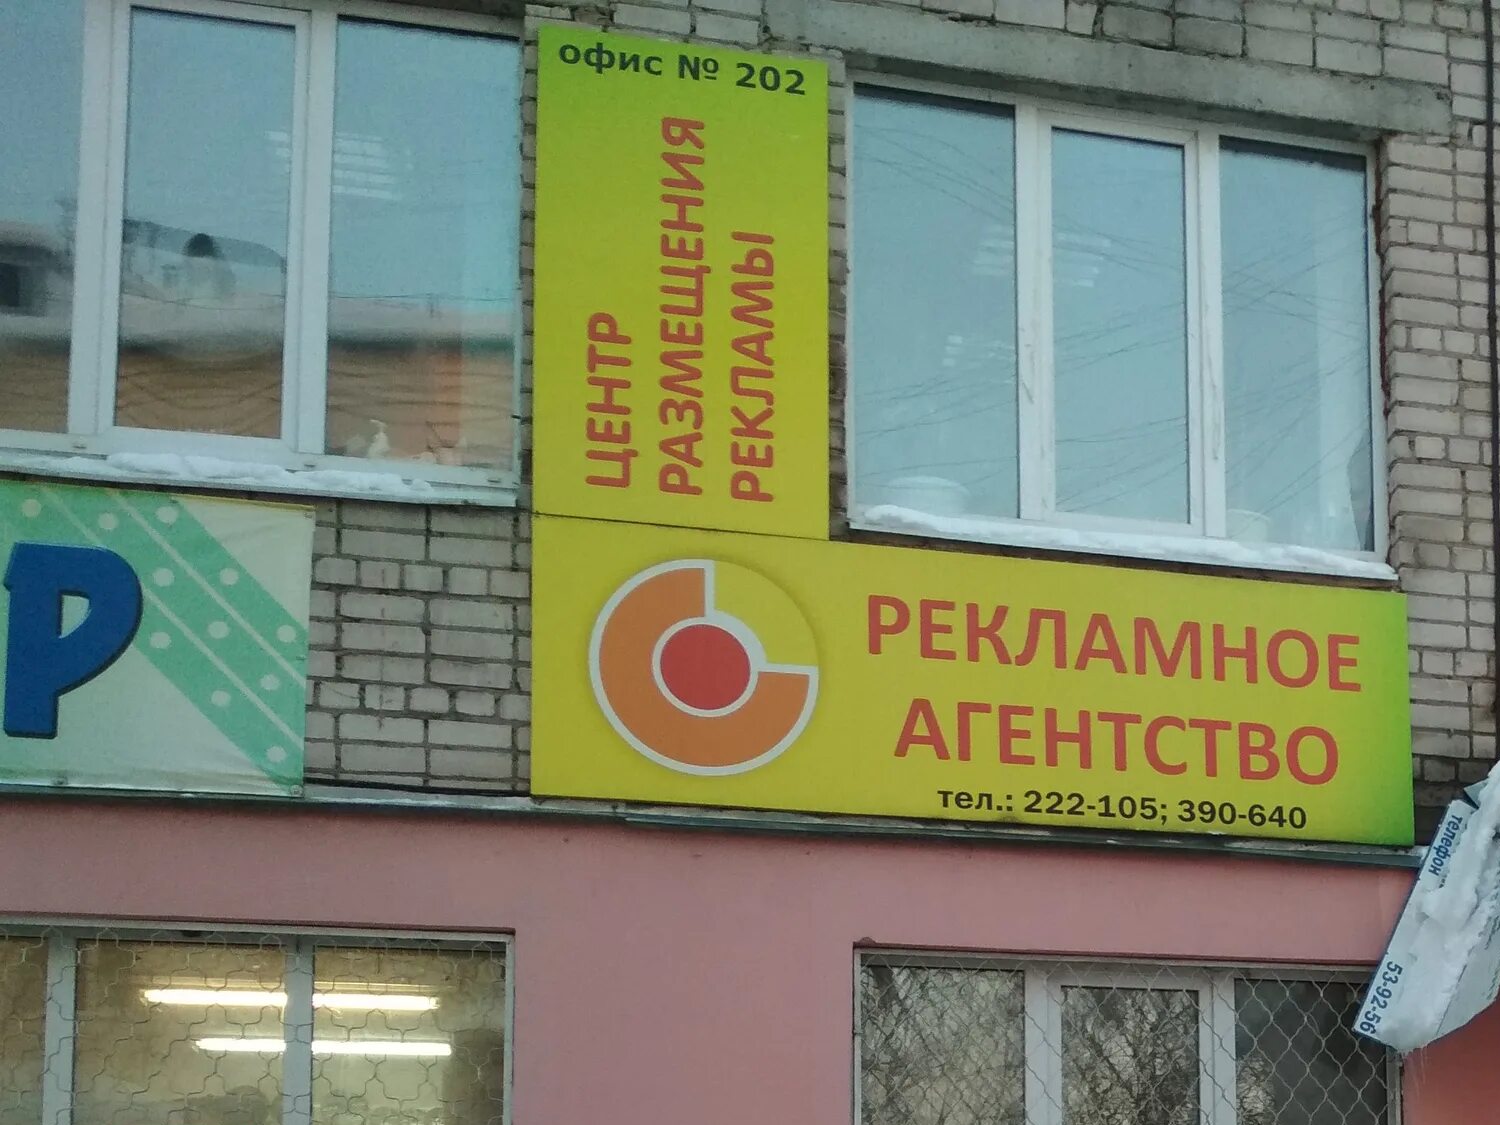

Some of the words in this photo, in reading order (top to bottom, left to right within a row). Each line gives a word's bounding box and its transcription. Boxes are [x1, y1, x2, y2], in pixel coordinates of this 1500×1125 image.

[559, 42, 662, 76] офис
[678, 54, 719, 81] №
[735, 62, 806, 95] 202
[658, 116, 711, 496] РАЗМЕЩЕНИЯ
[585, 312, 639, 488] ЦЕНТР
[730, 231, 775, 502] РЕКЛАМЫ
[867, 594, 1361, 693] РЕКЛАМНОЕ
[893, 698, 1339, 785] АГЕНТСТВО
[937, 789, 1014, 812] тел.:
[1023, 790, 1168, 825] 222-105;
[1177, 799, 1308, 830] 390-640
[1360, 961, 1404, 1034] 53-92-56
